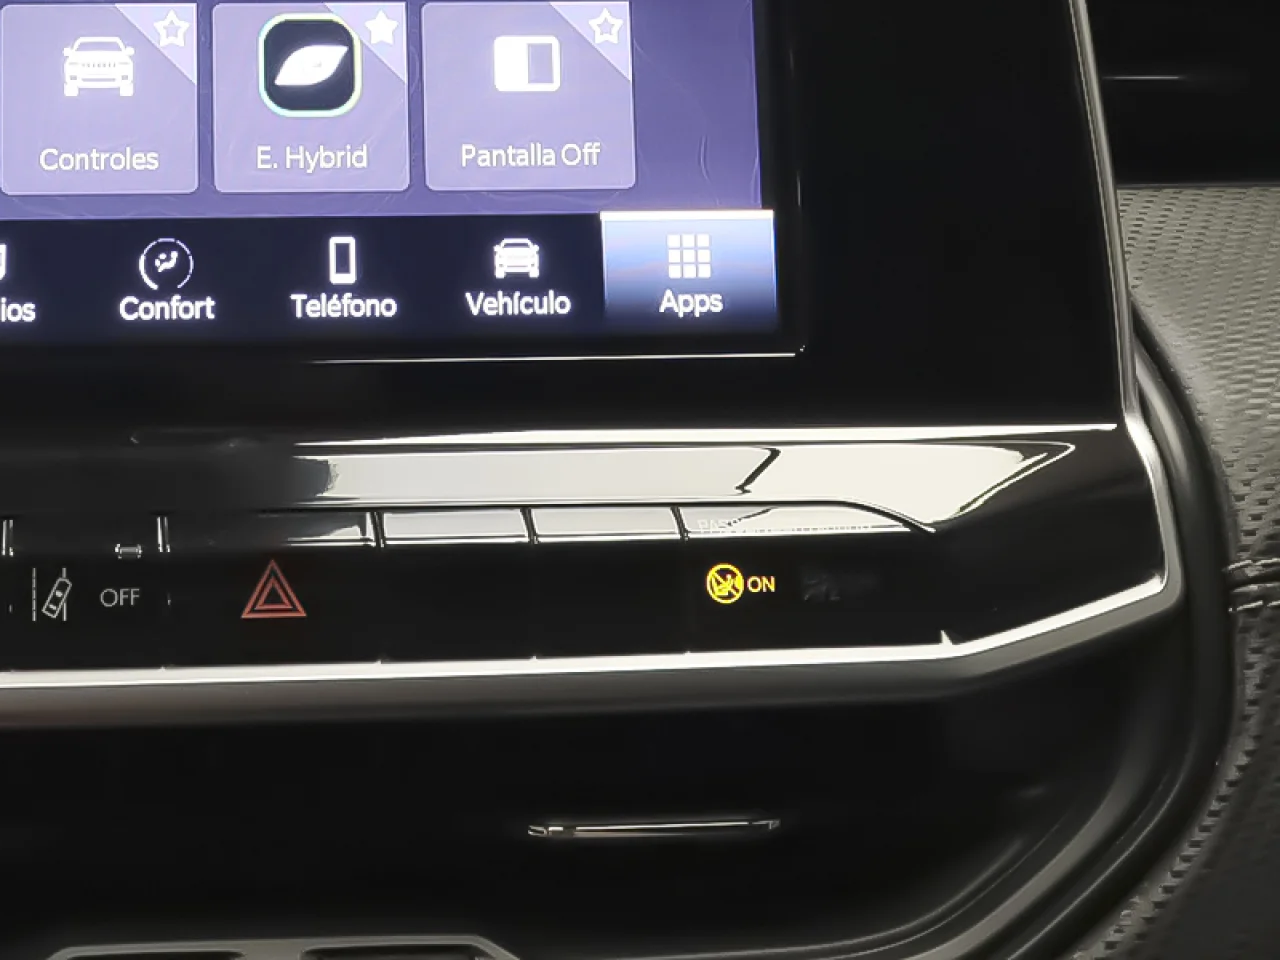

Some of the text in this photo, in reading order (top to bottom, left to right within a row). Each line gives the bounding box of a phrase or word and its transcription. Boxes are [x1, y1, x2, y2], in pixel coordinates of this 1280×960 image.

[40, 148, 159, 172] Controles
[256, 145, 368, 174] E. Hybrid
[461, 143, 601, 167] Pantalla Off
[119, 295, 215, 321] Confort
[291, 292, 397, 318] Teléfono
[465, 290, 571, 316] Vehículo
[659, 289, 723, 318] Apps
[747, 575, 776, 593] ON
[100, 588, 141, 609] OFF
